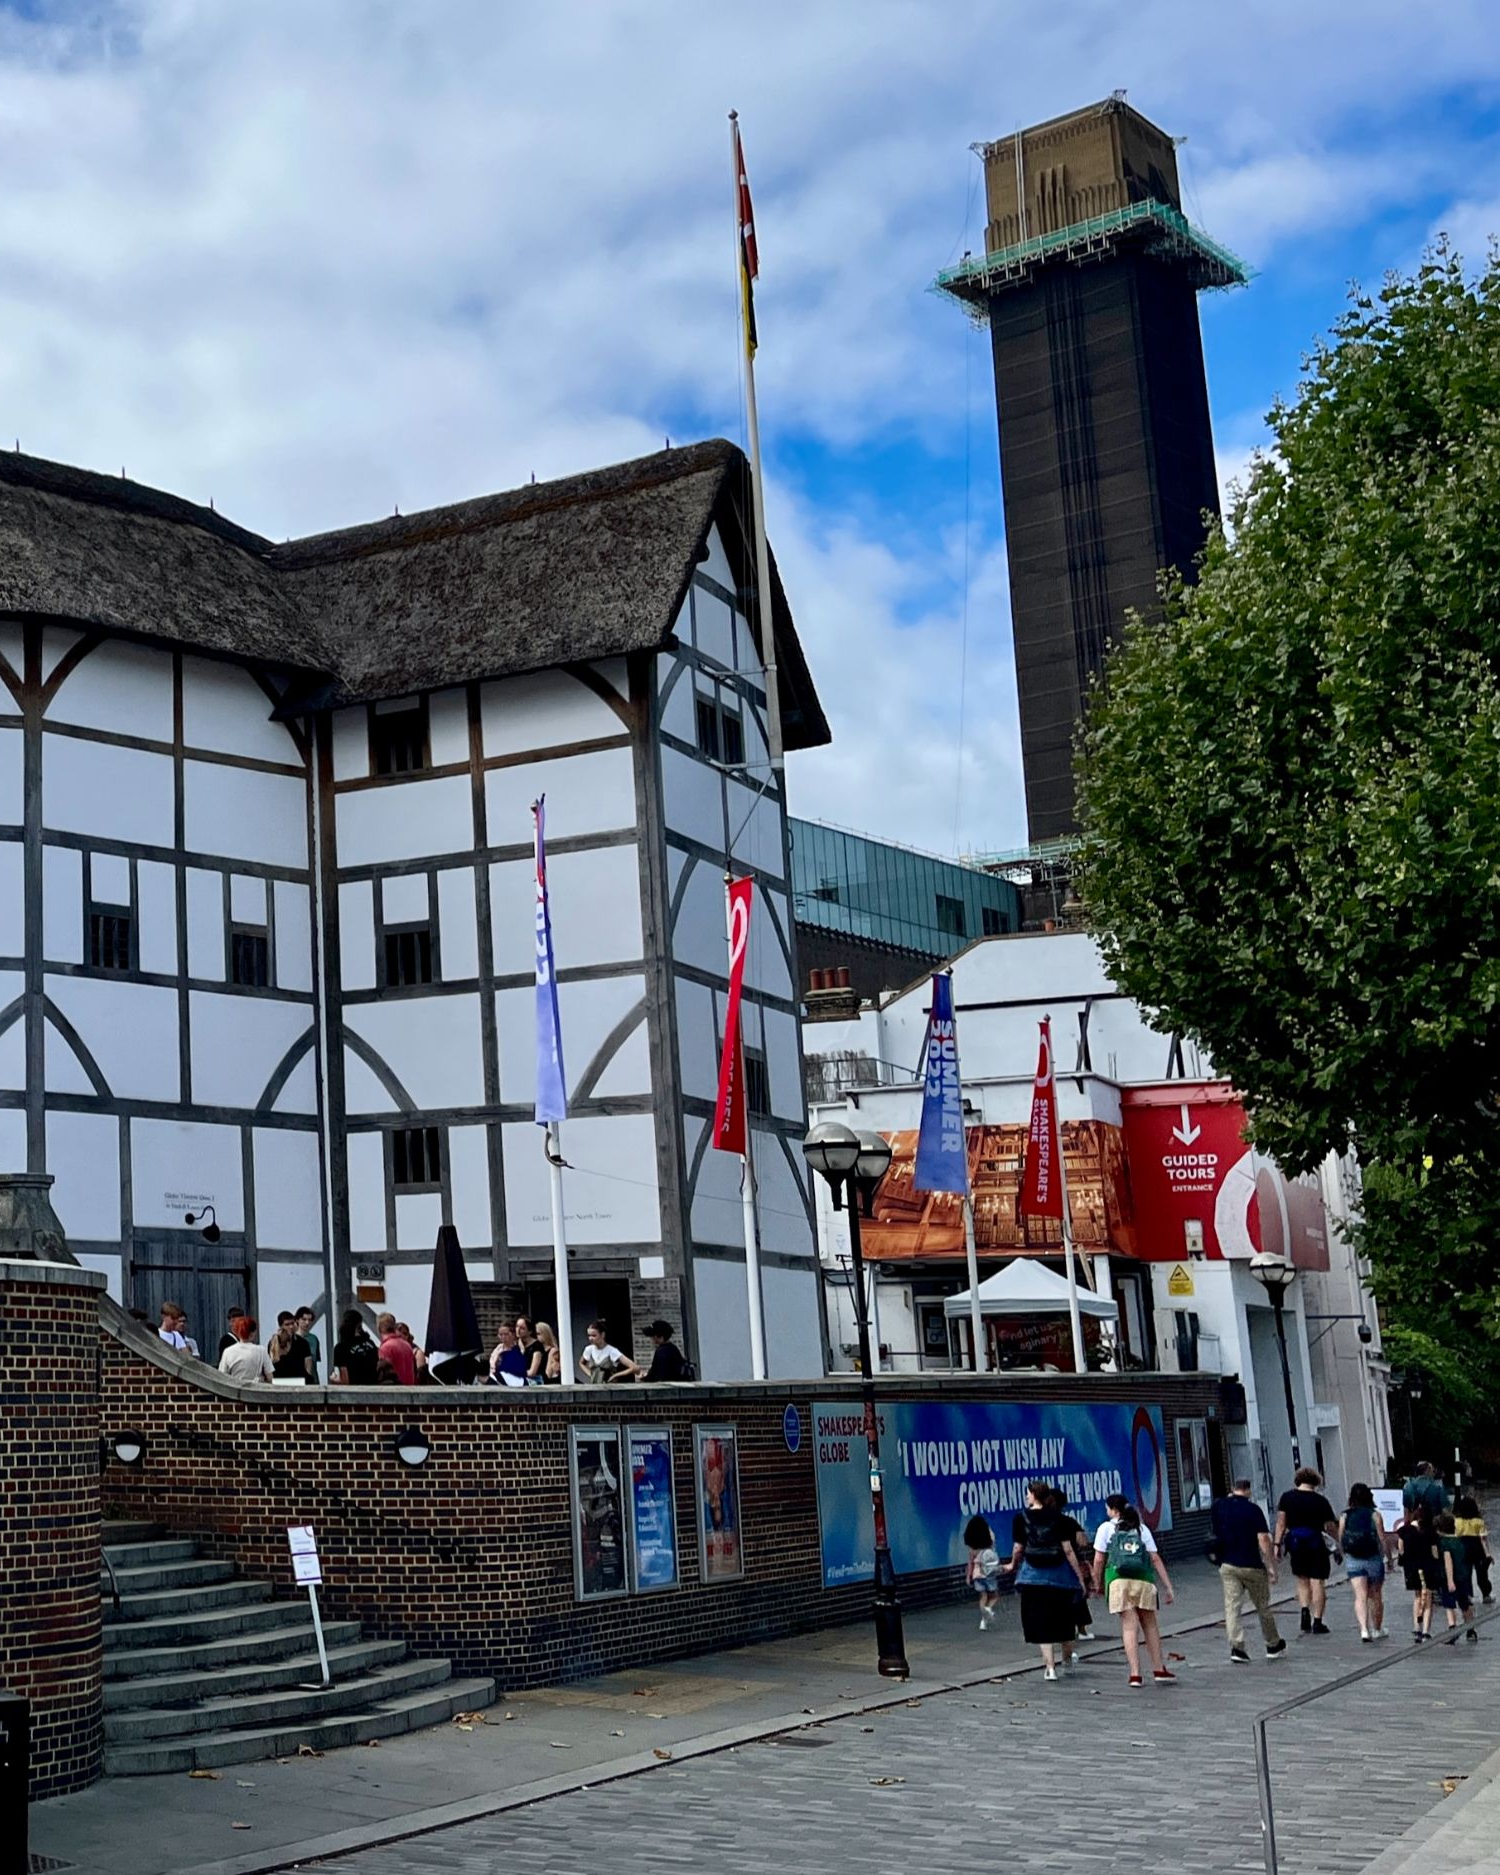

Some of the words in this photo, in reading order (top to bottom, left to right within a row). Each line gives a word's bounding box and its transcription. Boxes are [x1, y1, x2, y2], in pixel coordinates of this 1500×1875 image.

[926, 1020, 940, 1097] 2022
[941, 1020, 960, 1152] SUMMER
[1031, 1098, 1039, 1142] GLOBE
[1037, 1099, 1049, 1203] SHAKESPEARE'S
[1162, 1154, 1218, 1166] GUIDED
[1166, 1168, 1216, 1180] TOURS
[1172, 1184, 1214, 1192] ENTRANCE
[818, 1416, 885, 1437] SHAKESPE'S
[820, 1442, 850, 1464] GLOBE
[912, 1440, 968, 1476] WOULD
[971, 1440, 1000, 1474] NOT
[1003, 1438, 1038, 1471] WISH
[1041, 1438, 1065, 1468] ANY
[959, 1476, 1038, 1516] COMPANIO
[1058, 1474, 1082, 1504] THE
[1082, 1470, 1122, 1502] WORLD
